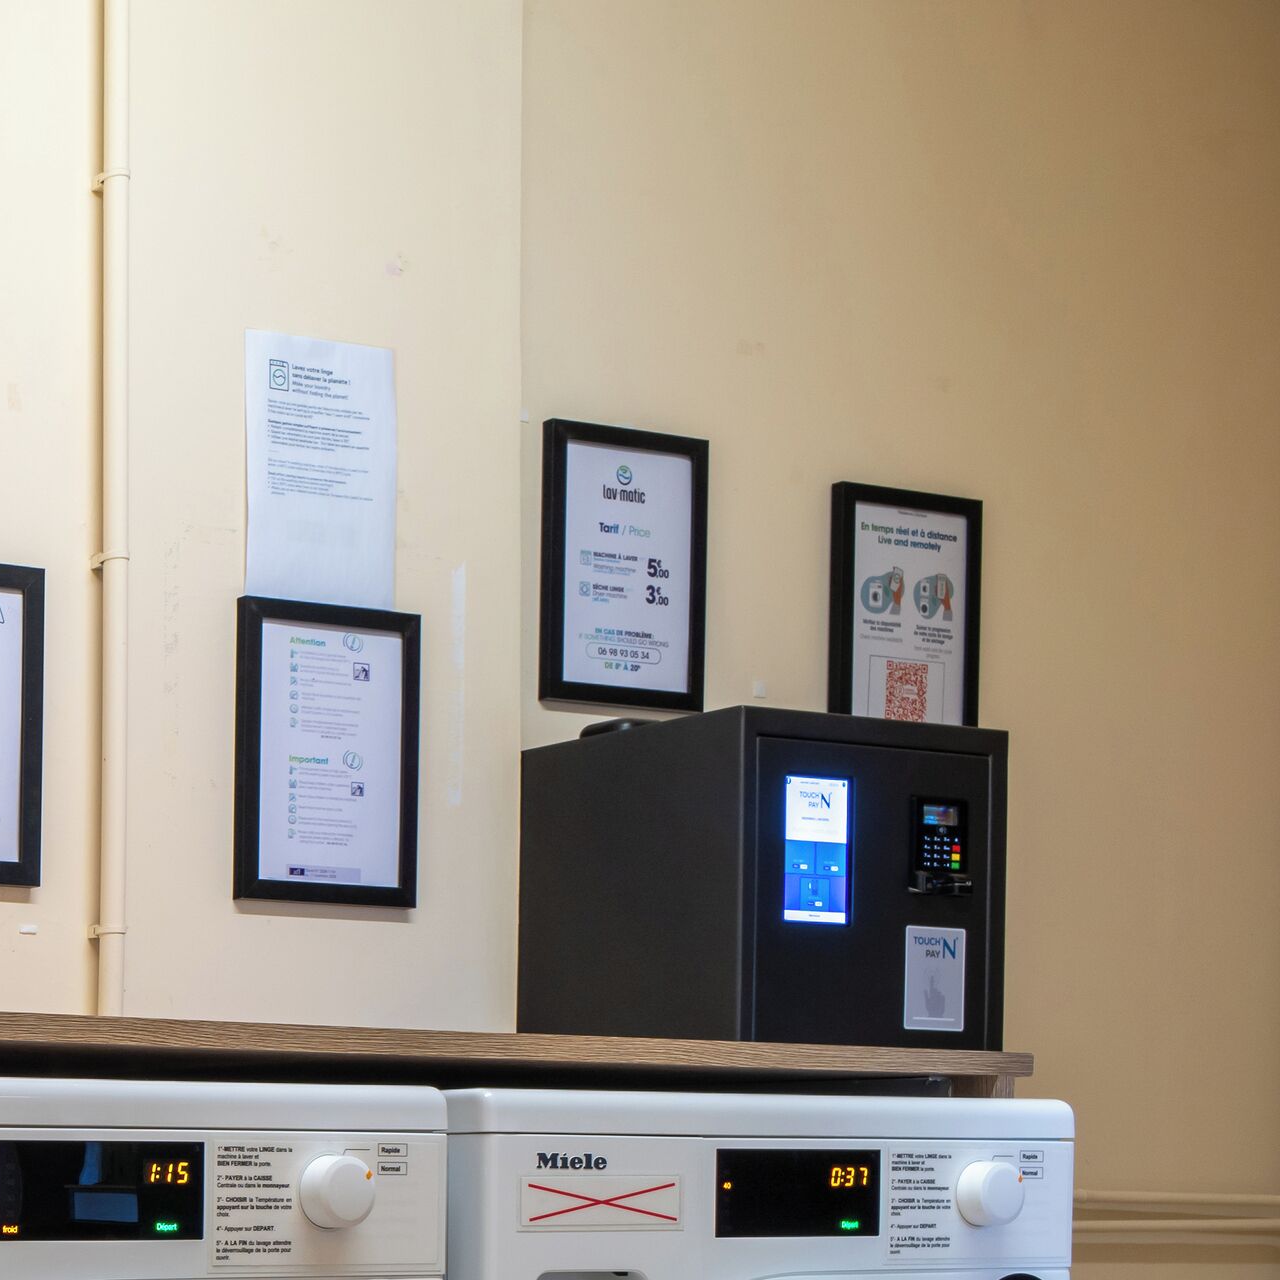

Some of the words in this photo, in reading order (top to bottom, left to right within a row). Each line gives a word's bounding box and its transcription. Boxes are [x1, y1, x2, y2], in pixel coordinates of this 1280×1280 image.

[599, 522, 620, 534] Tarif
[629, 525, 651, 538] Price
[861, 522, 869, 531] En
[871, 523, 894, 535] temps
[896, 525, 910, 536] réel
[911, 528, 918, 537] et
[920, 529, 926, 538] à
[927, 531, 958, 543] distance
[878, 535, 892, 545] Live
[894, 537, 909, 547] and
[910, 540, 942, 553] remotely
[290, 636, 327, 647] Attention
[598, 647, 607, 656] 06
[609, 648, 618, 657] 98
[620, 649, 628, 658] 93
[630, 650, 639, 659] 05
[641, 651, 650, 660] 34
[289, 754, 329, 765] Important
[913, 936, 940, 946] TOUCH
[926, 949, 940, 958] PAY
[381, 1146, 400, 1154] Rapide
[536, 1151, 608, 1171] Miele
[150, 1162, 189, 1184] 1:15
[831, 1167, 868, 1187] 0:37
[723, 1182, 732, 1190] 40
[2, 1225, 19, 1234] froid
[156, 1222, 178, 1233] Départ
